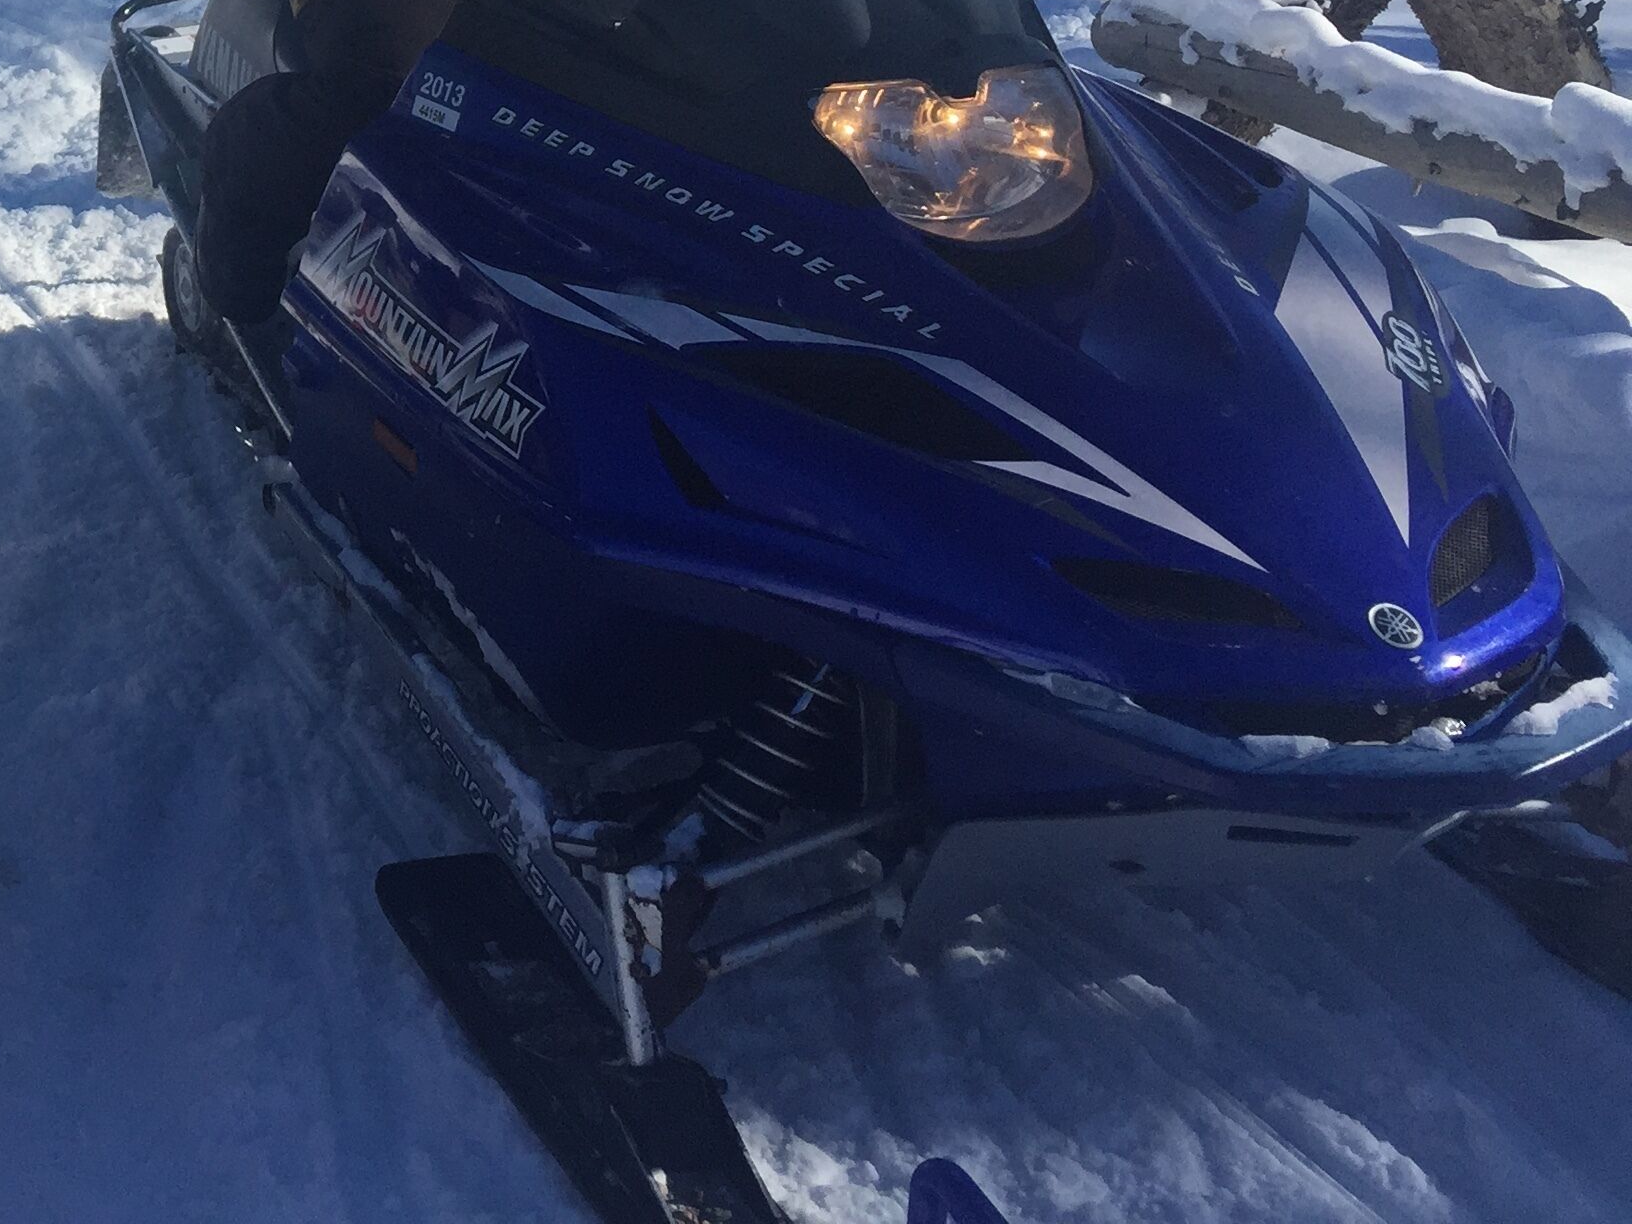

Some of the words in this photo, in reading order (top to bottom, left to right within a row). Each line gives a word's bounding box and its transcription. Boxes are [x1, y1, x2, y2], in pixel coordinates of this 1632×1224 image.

[420, 71, 466, 107] 2013
[491, 106, 596, 157] DEEP
[604, 158, 735, 223] SNOW
[740, 223, 944, 340] SPECIAL
[498, 826, 603, 975] SSTEM
